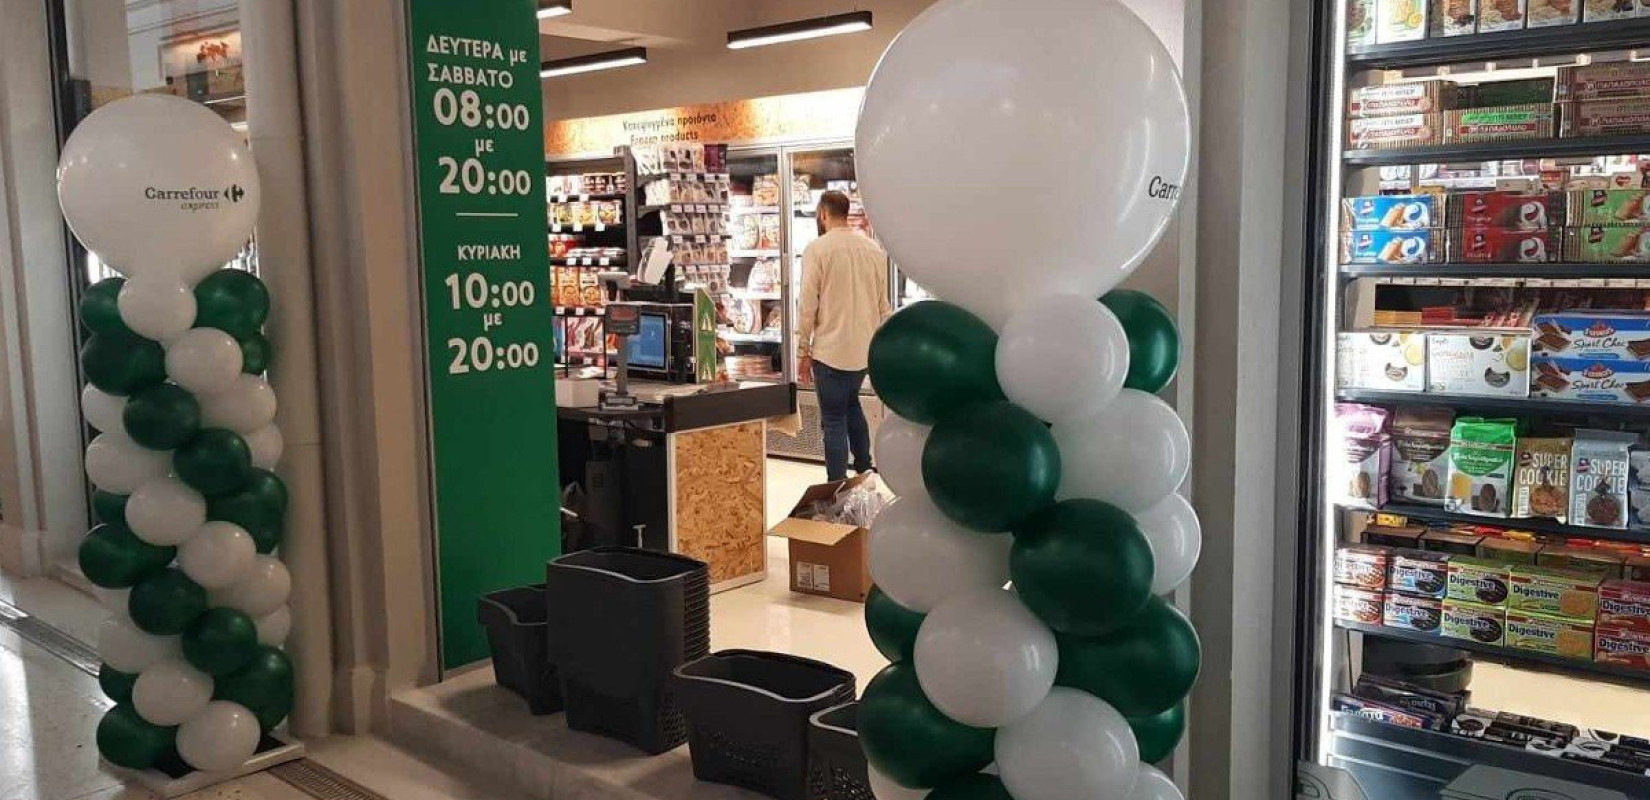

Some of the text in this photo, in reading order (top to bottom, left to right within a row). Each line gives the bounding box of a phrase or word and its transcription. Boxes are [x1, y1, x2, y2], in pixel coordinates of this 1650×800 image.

[426, 34, 527, 66] ΔΕΥΤΕΡΑ με
[427, 62, 513, 89] ΣΑΒΒΑΤΟ
[433, 87, 529, 131] 08:00
[475, 137, 494, 157] με
[438, 157, 531, 196] 20:00
[145, 186, 219, 200] Carrefour
[457, 245, 521, 261] ΚΥΡΙΑΚΗ
[445, 272, 535, 310] 10:00
[483, 312, 503, 332] με
[448, 336, 539, 375] 20:00
[1532, 453, 1568, 470] SUPER
[1590, 458, 1626, 476] SUPER
[1576, 475, 1626, 495] COOIE
[1389, 565, 1434, 581] Digestive
[1450, 575, 1496, 590] Digestive
[1513, 585, 1560, 600] Digestive
[1386, 603, 1429, 619] Digestive
[1444, 613, 1490, 629] Digestive
[1509, 624, 1556, 639] Digestive
[1599, 638, 1650, 653] Digestive
